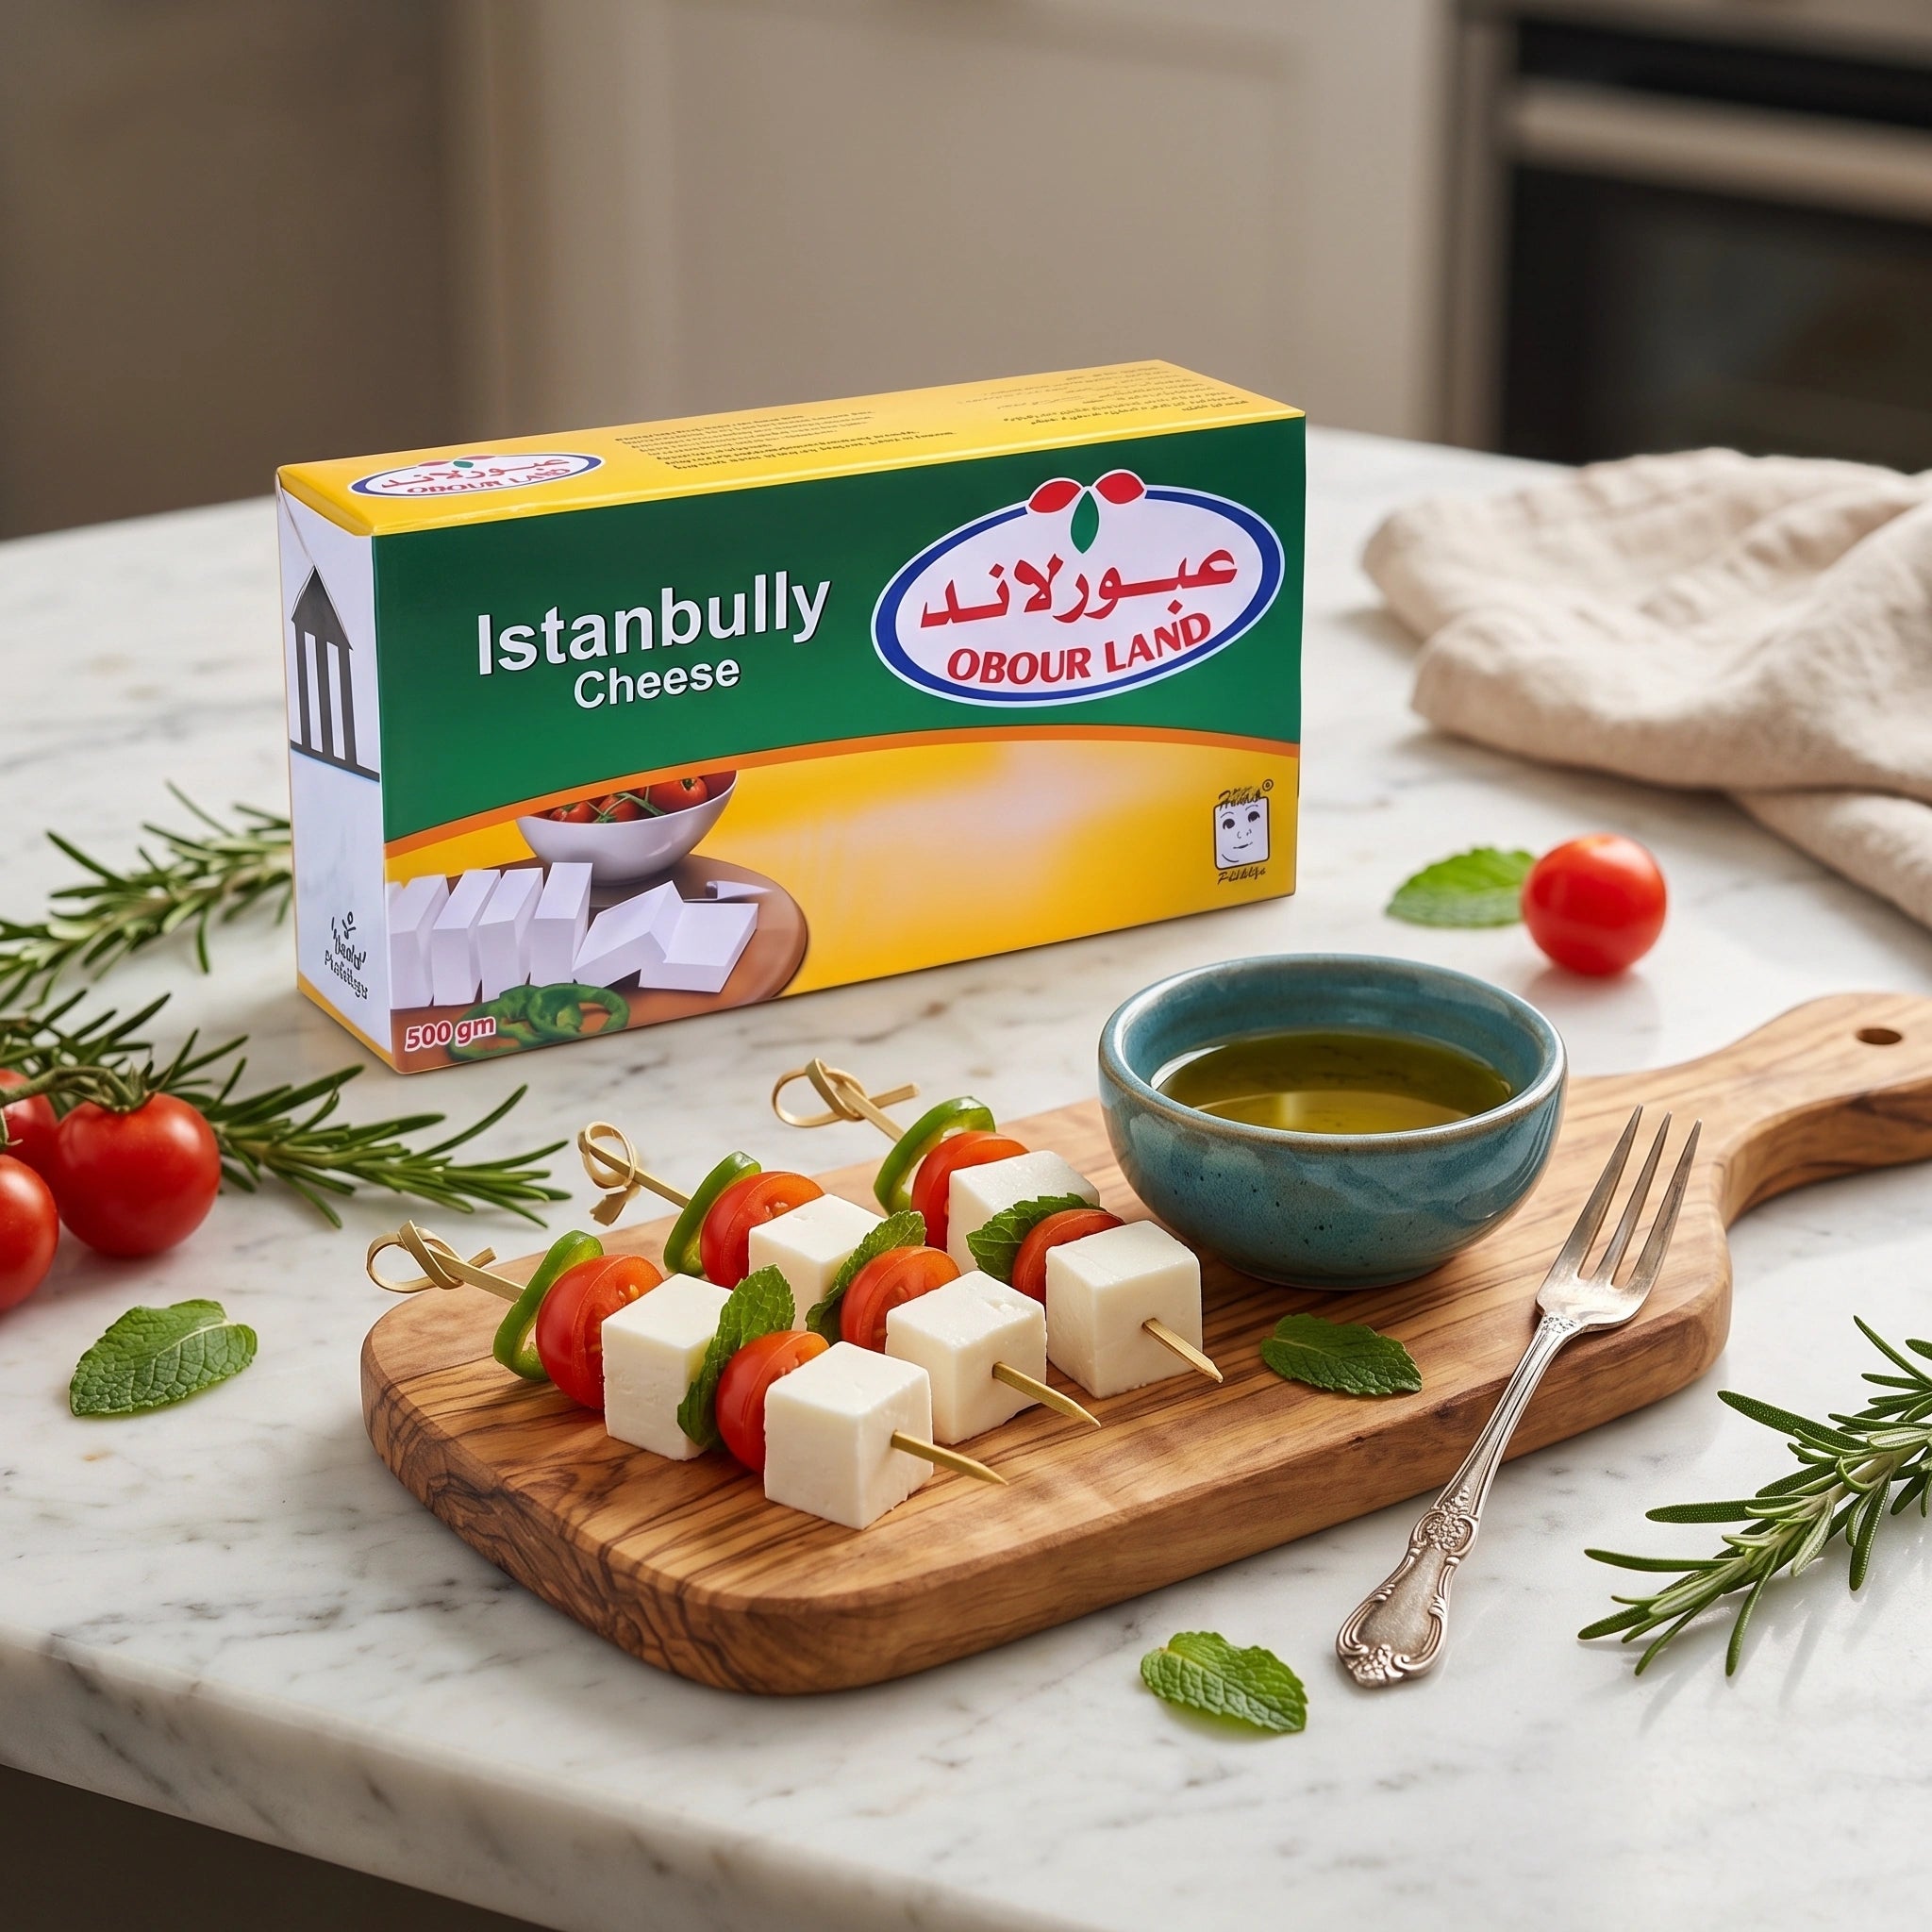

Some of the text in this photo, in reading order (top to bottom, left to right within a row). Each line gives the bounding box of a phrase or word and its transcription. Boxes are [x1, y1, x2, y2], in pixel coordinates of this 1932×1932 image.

[477, 570, 832, 675] Istanbully
[920, 549, 1238, 628] عبورلاند
[574, 658, 741, 709] Cheese
[947, 612, 1211, 685] OBOUR LAND
[405, 1016, 497, 1052] 500 gm
